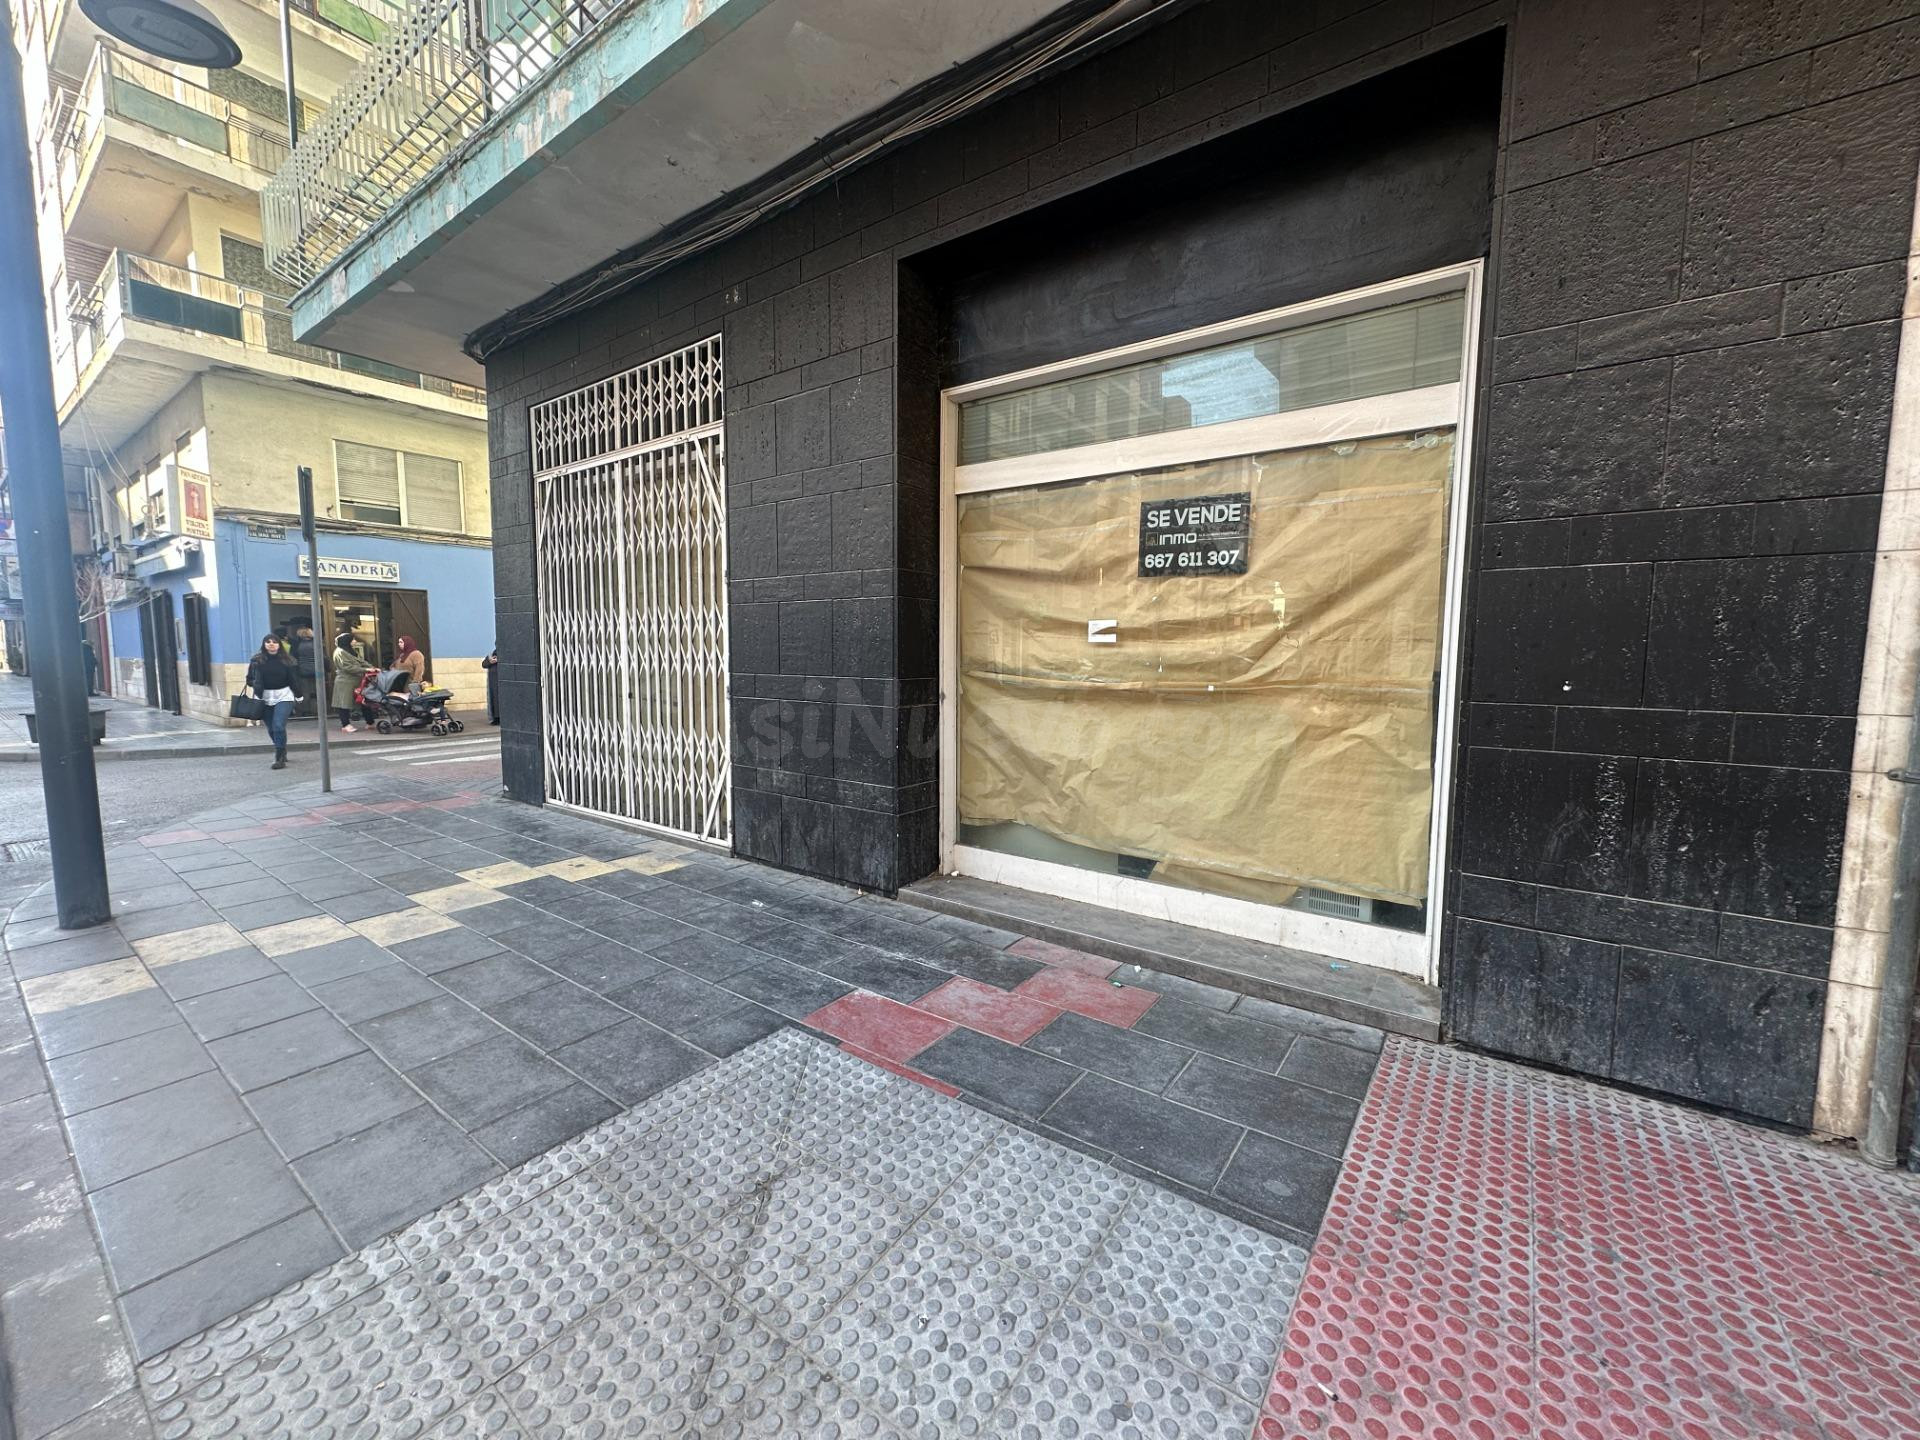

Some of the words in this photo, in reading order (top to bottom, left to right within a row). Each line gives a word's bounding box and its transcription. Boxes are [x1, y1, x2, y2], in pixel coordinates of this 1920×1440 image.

[1146, 509, 1171, 528] SE
[1174, 503, 1242, 526] VENDE
[1144, 553, 1174, 568] 667
[1178, 551, 1203, 567] 611
[1207, 549, 1240, 565] 307
